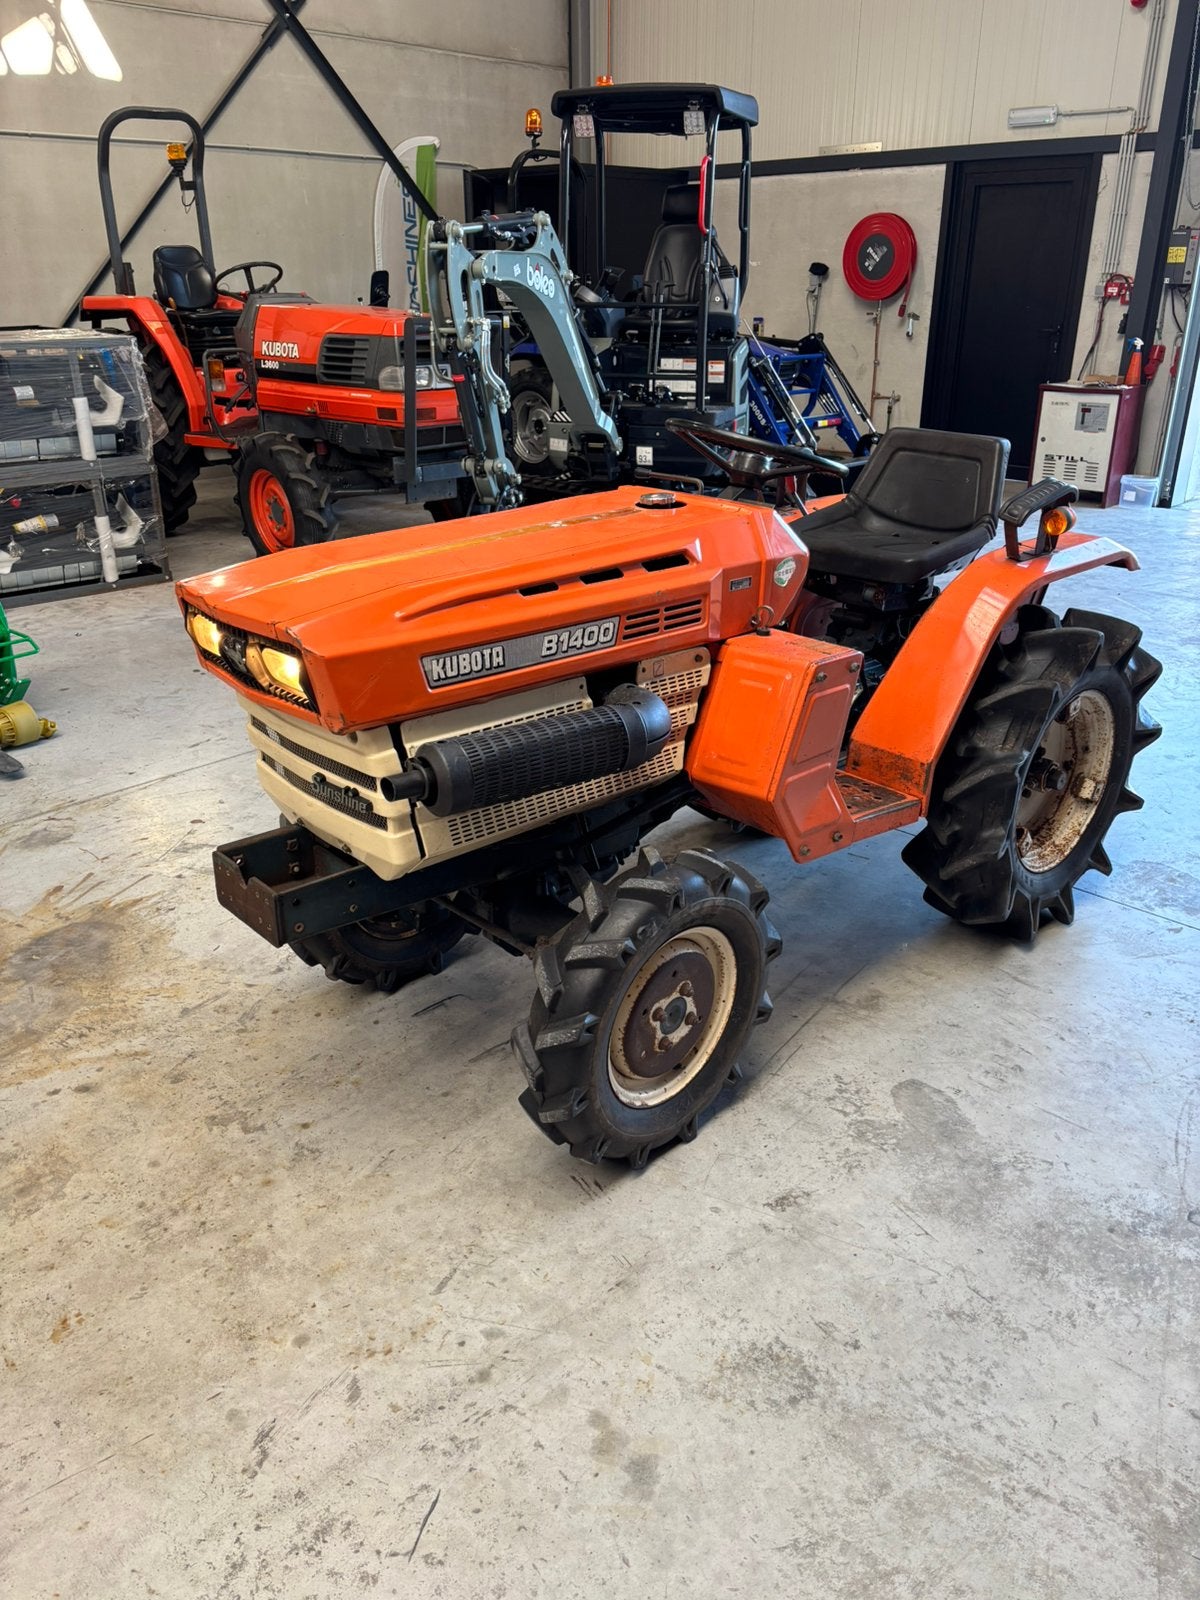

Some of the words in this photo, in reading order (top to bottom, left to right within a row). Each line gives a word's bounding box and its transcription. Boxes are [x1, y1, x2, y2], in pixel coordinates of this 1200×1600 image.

[261, 341, 300, 358] KUBOTA
[260, 359, 280, 369] L3600
[1044, 453, 1088, 462] STILL
[431, 646, 505, 682] KUBOTA
[540, 621, 617, 658] B1400
[311, 773, 368, 814] Sunshine
